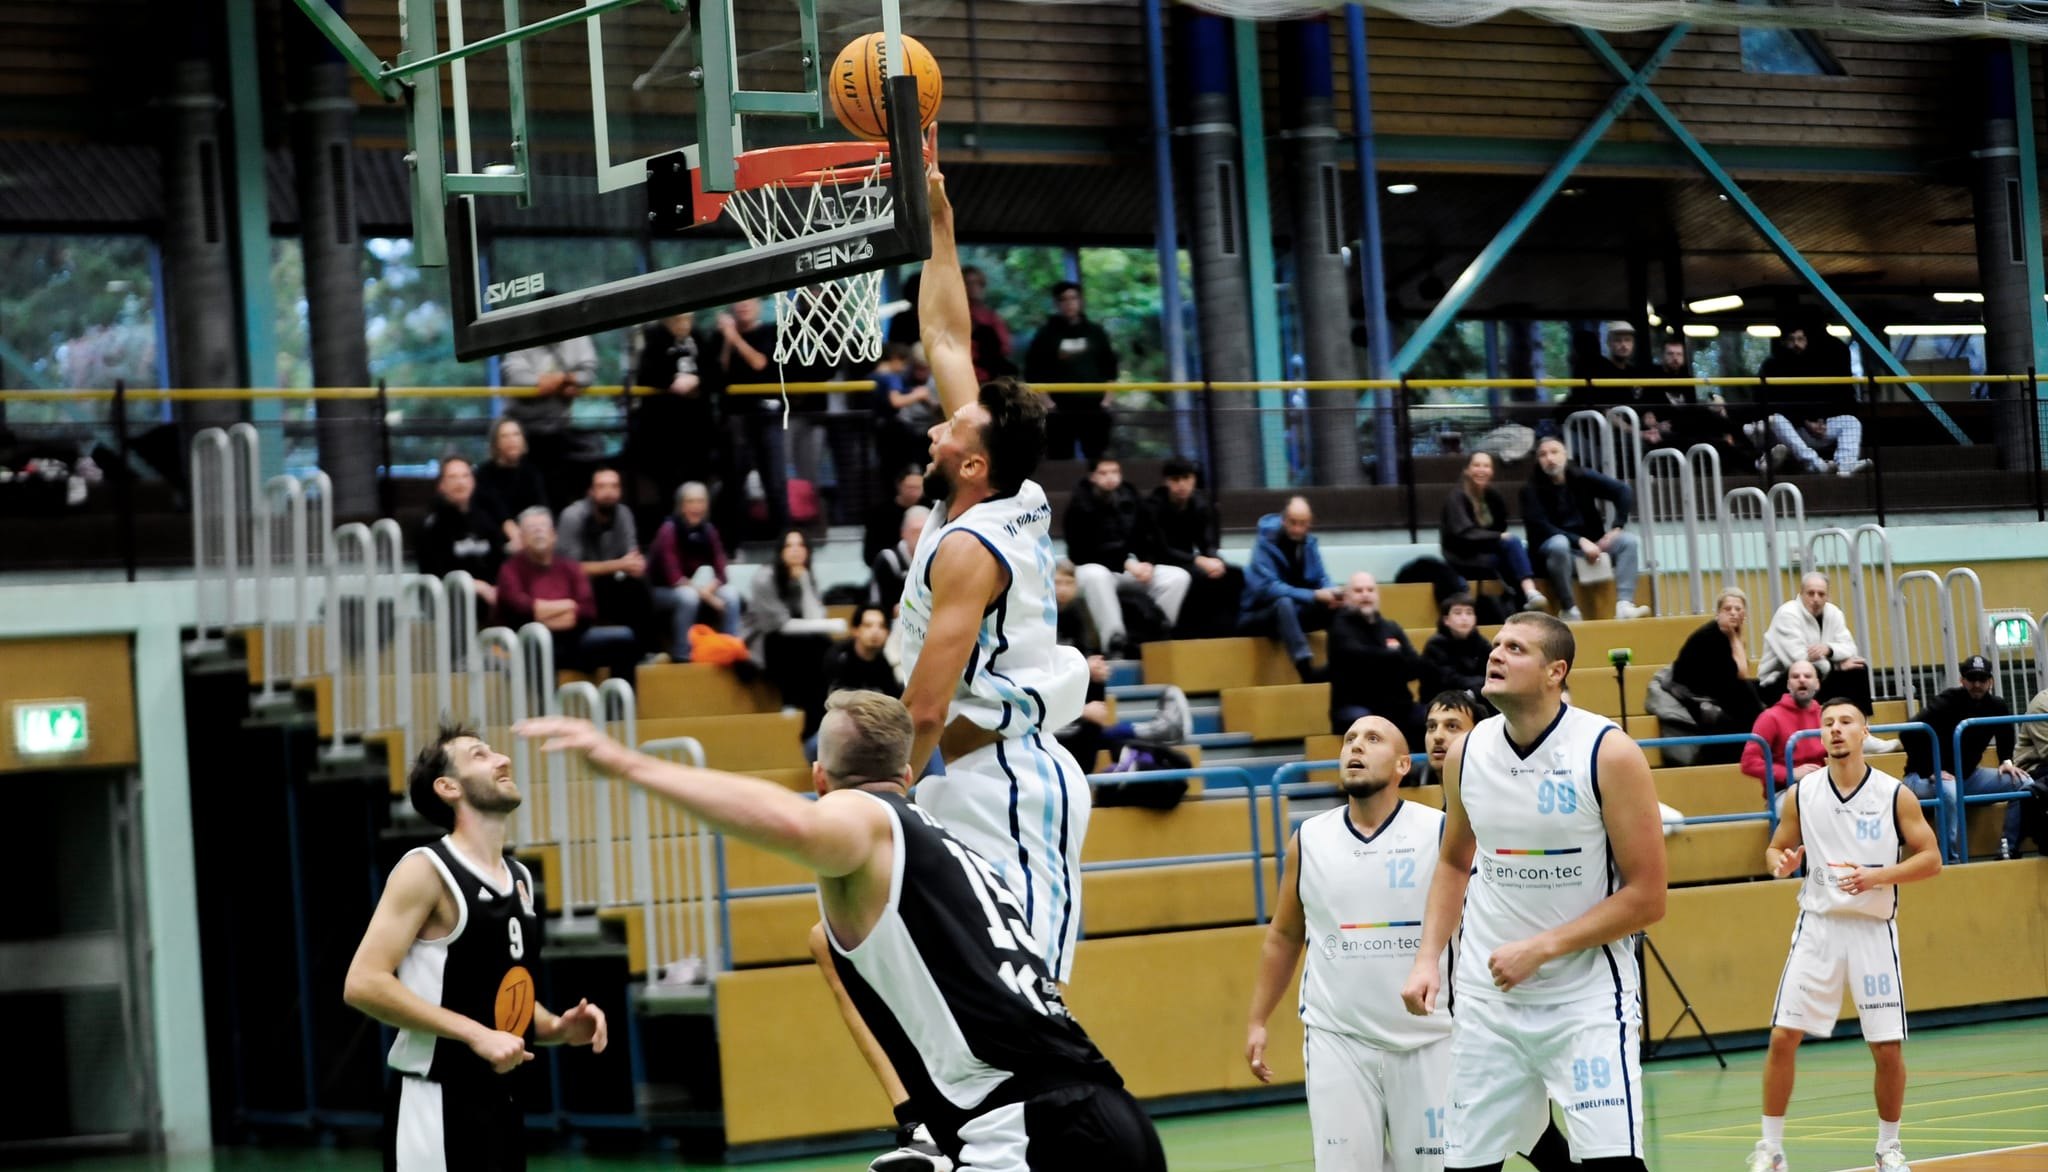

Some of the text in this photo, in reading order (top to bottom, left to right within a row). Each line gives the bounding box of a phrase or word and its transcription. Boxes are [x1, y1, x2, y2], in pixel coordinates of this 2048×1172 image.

[1537, 779, 1577, 815] 99
[1385, 857, 1416, 888] 12
[508, 916, 525, 960] 9
[1863, 973, 1891, 997] 88
[1573, 1055, 1612, 1092] 99
